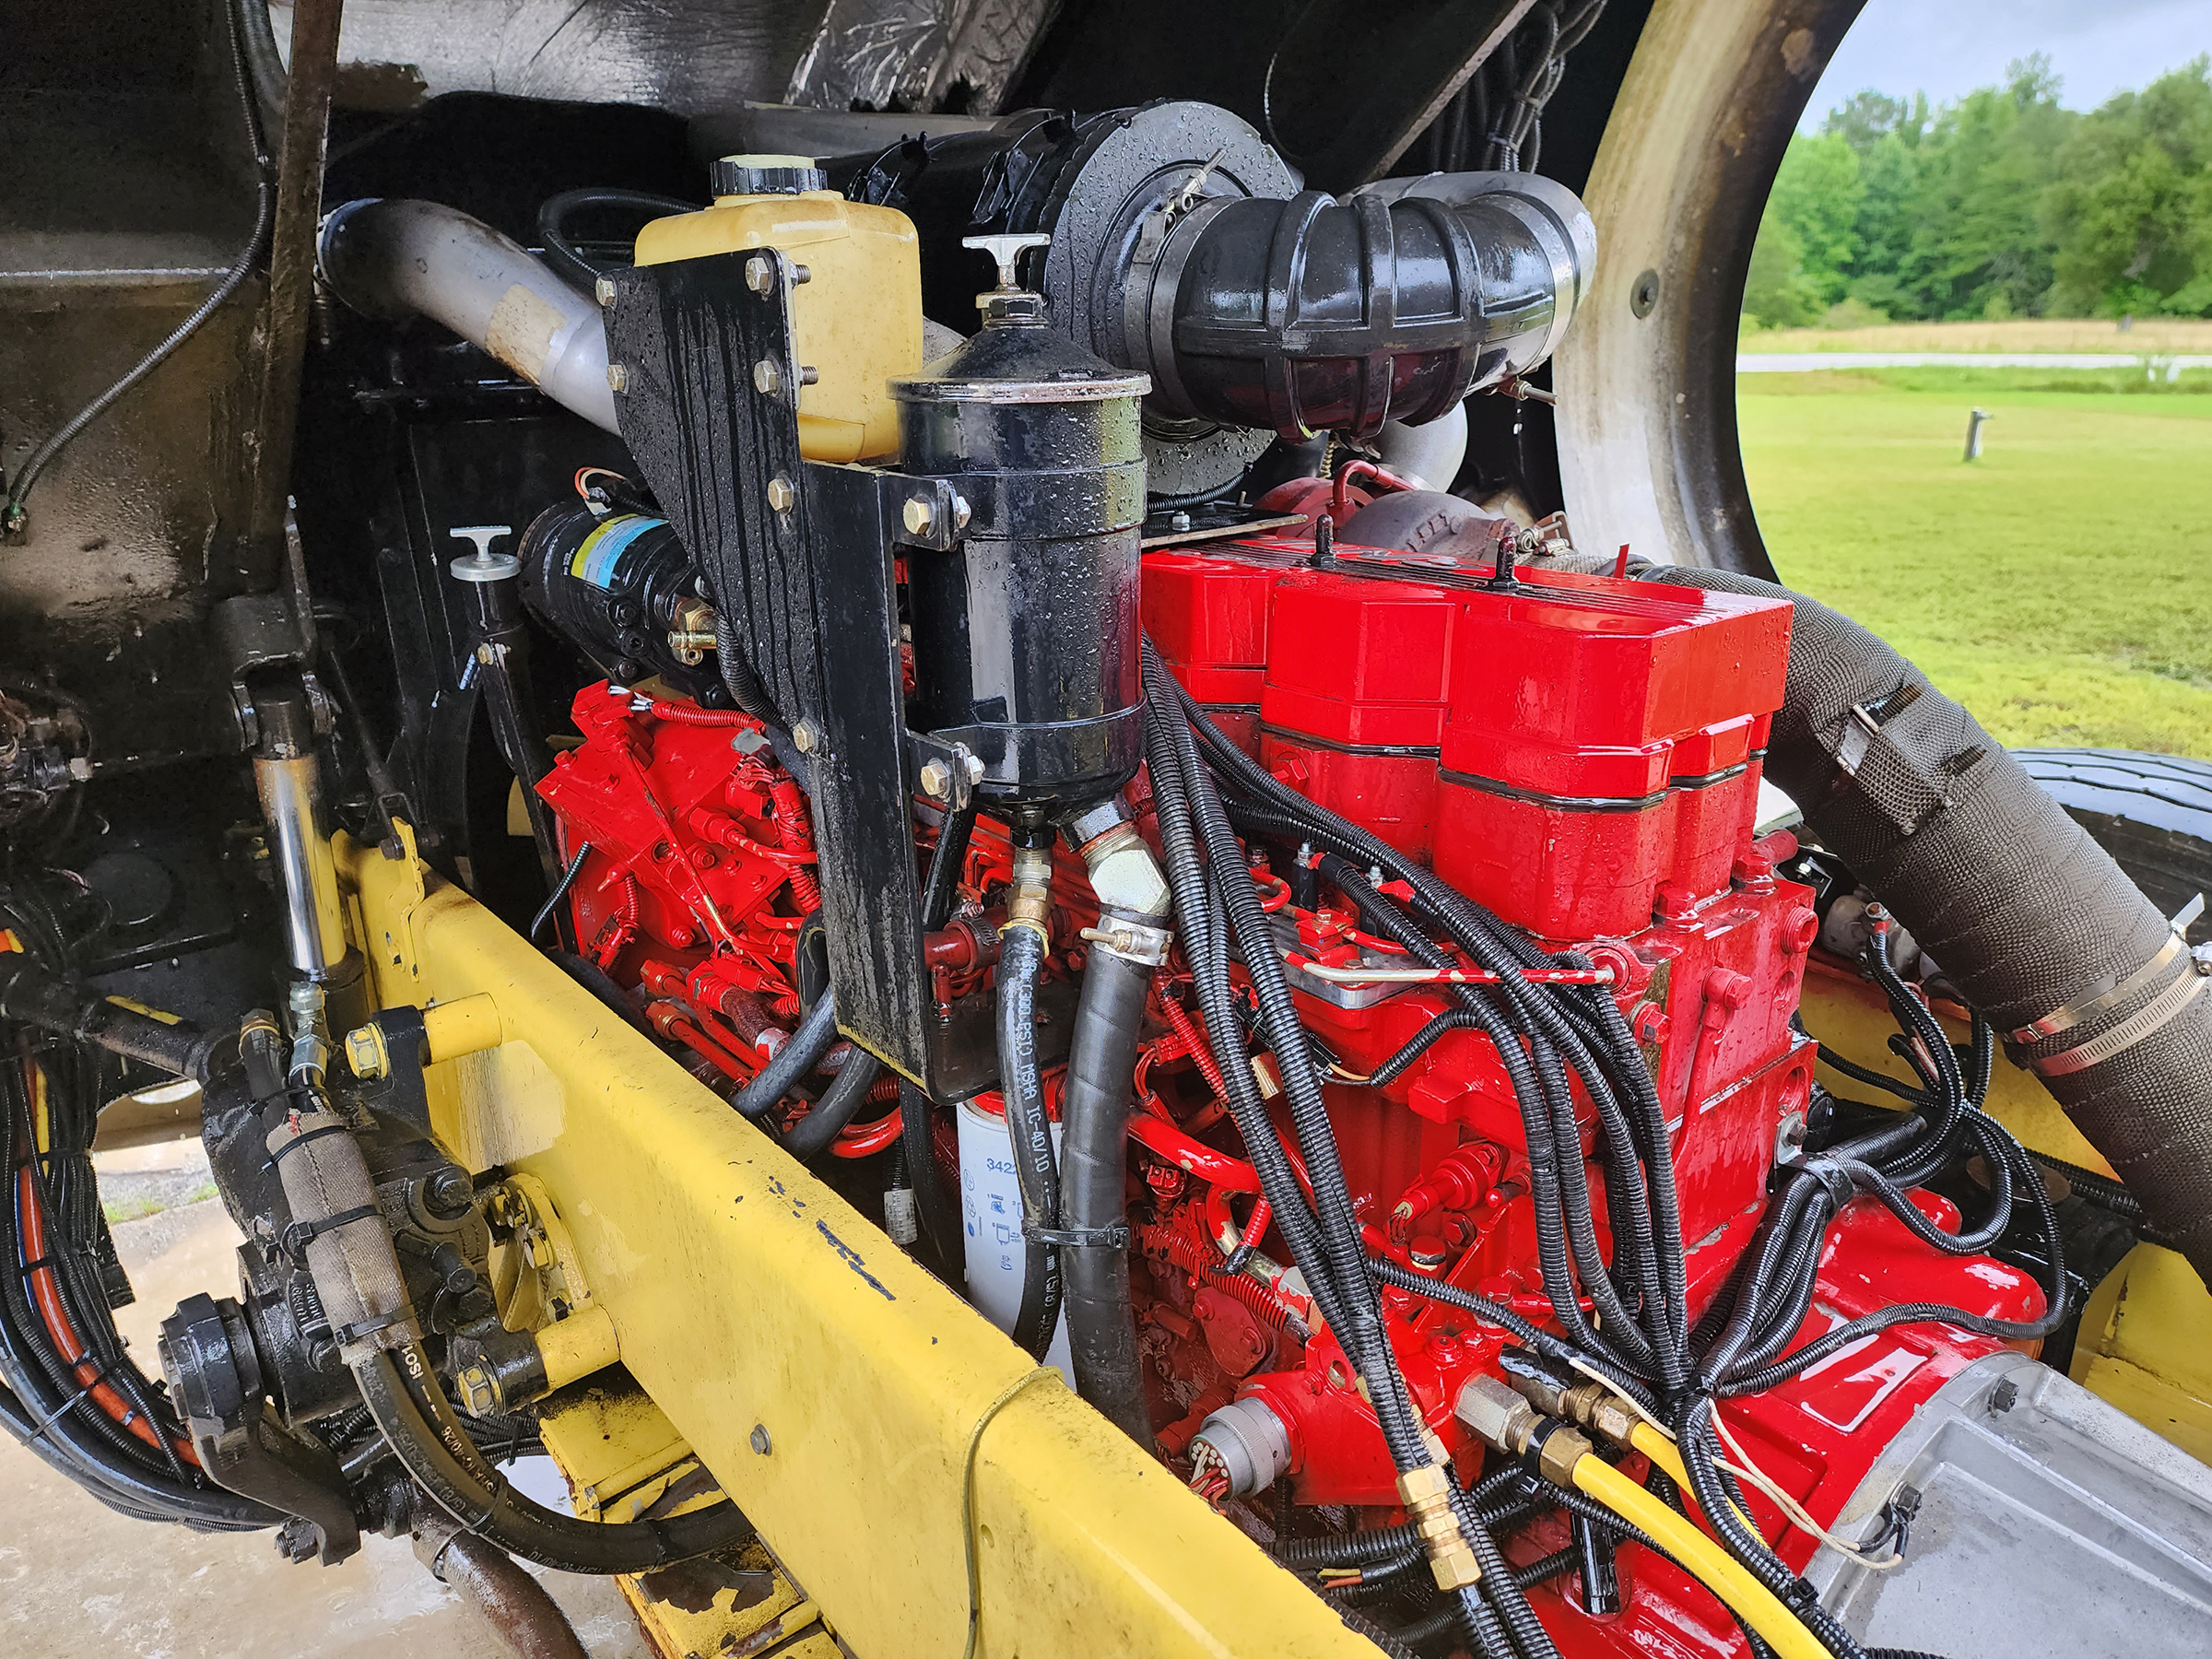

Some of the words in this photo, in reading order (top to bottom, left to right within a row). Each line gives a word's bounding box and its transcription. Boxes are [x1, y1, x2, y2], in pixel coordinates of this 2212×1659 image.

[1018, 1021, 1033, 1056] PSI)
[1020, 1063, 1038, 1100] MSHA
[1027, 1104, 1050, 1173] IC-40/10
[1046, 1254, 1056, 1272] mm
[1044, 1276, 1059, 1307] (5/8)
[441, 1425, 477, 1472] IC-40/26
